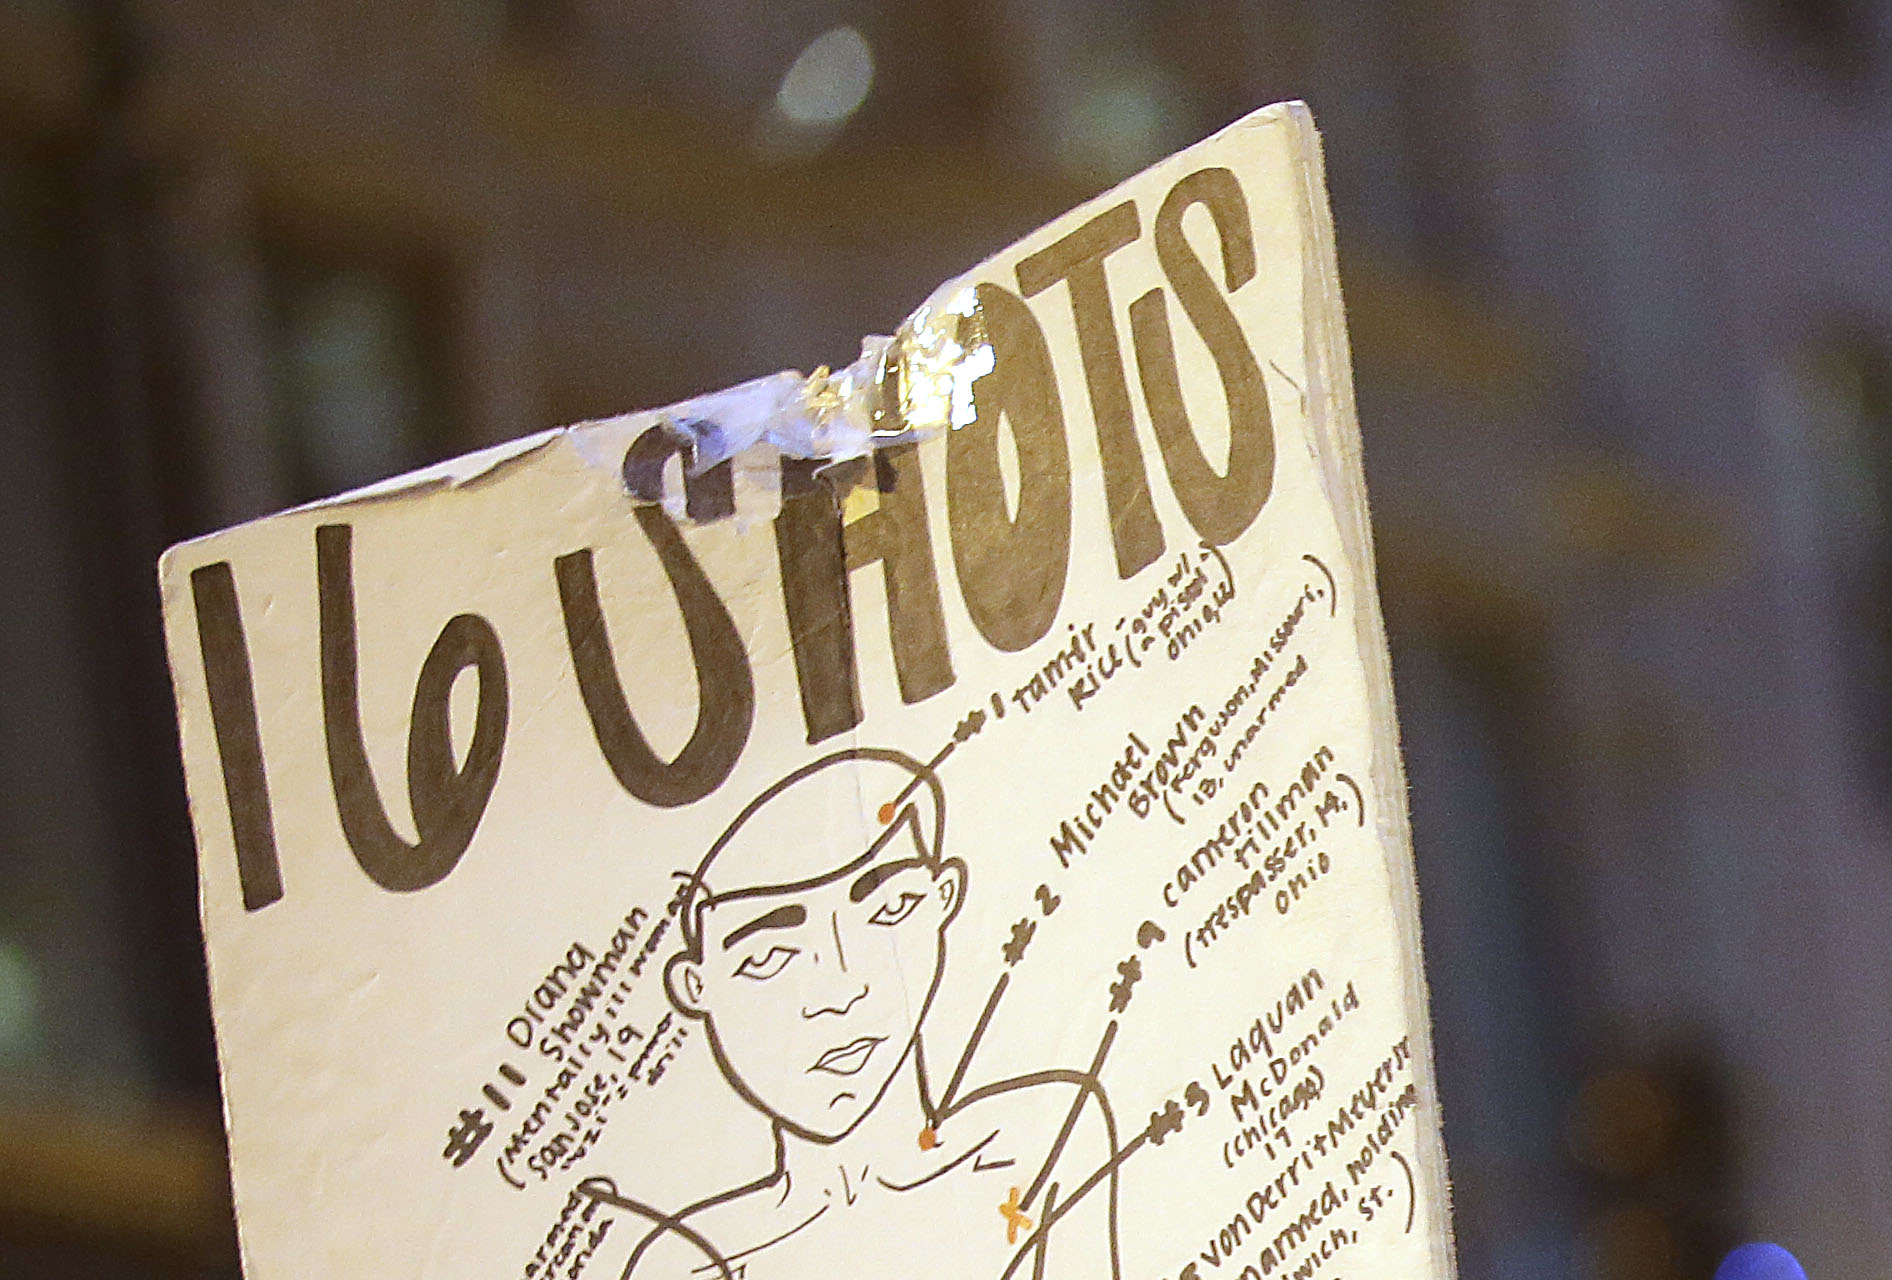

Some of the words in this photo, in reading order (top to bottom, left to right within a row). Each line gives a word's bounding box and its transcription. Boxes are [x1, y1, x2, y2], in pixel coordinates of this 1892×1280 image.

[190, 524, 510, 912] 16
[554, 164, 1278, 806] SHOTS
[1128, 706, 1204, 818] Brown
[1002, 884, 1061, 967] #2
[1050, 733, 1149, 868] Michael
[442, 1064, 526, 1168] #11
[507, 942, 595, 1049] Diana
[540, 907, 648, 1062] Showman
[608, 1025, 643, 1062] 19
[1212, 969, 1323, 1090] Laquan
[1231, 982, 1359, 1122] McDonald
